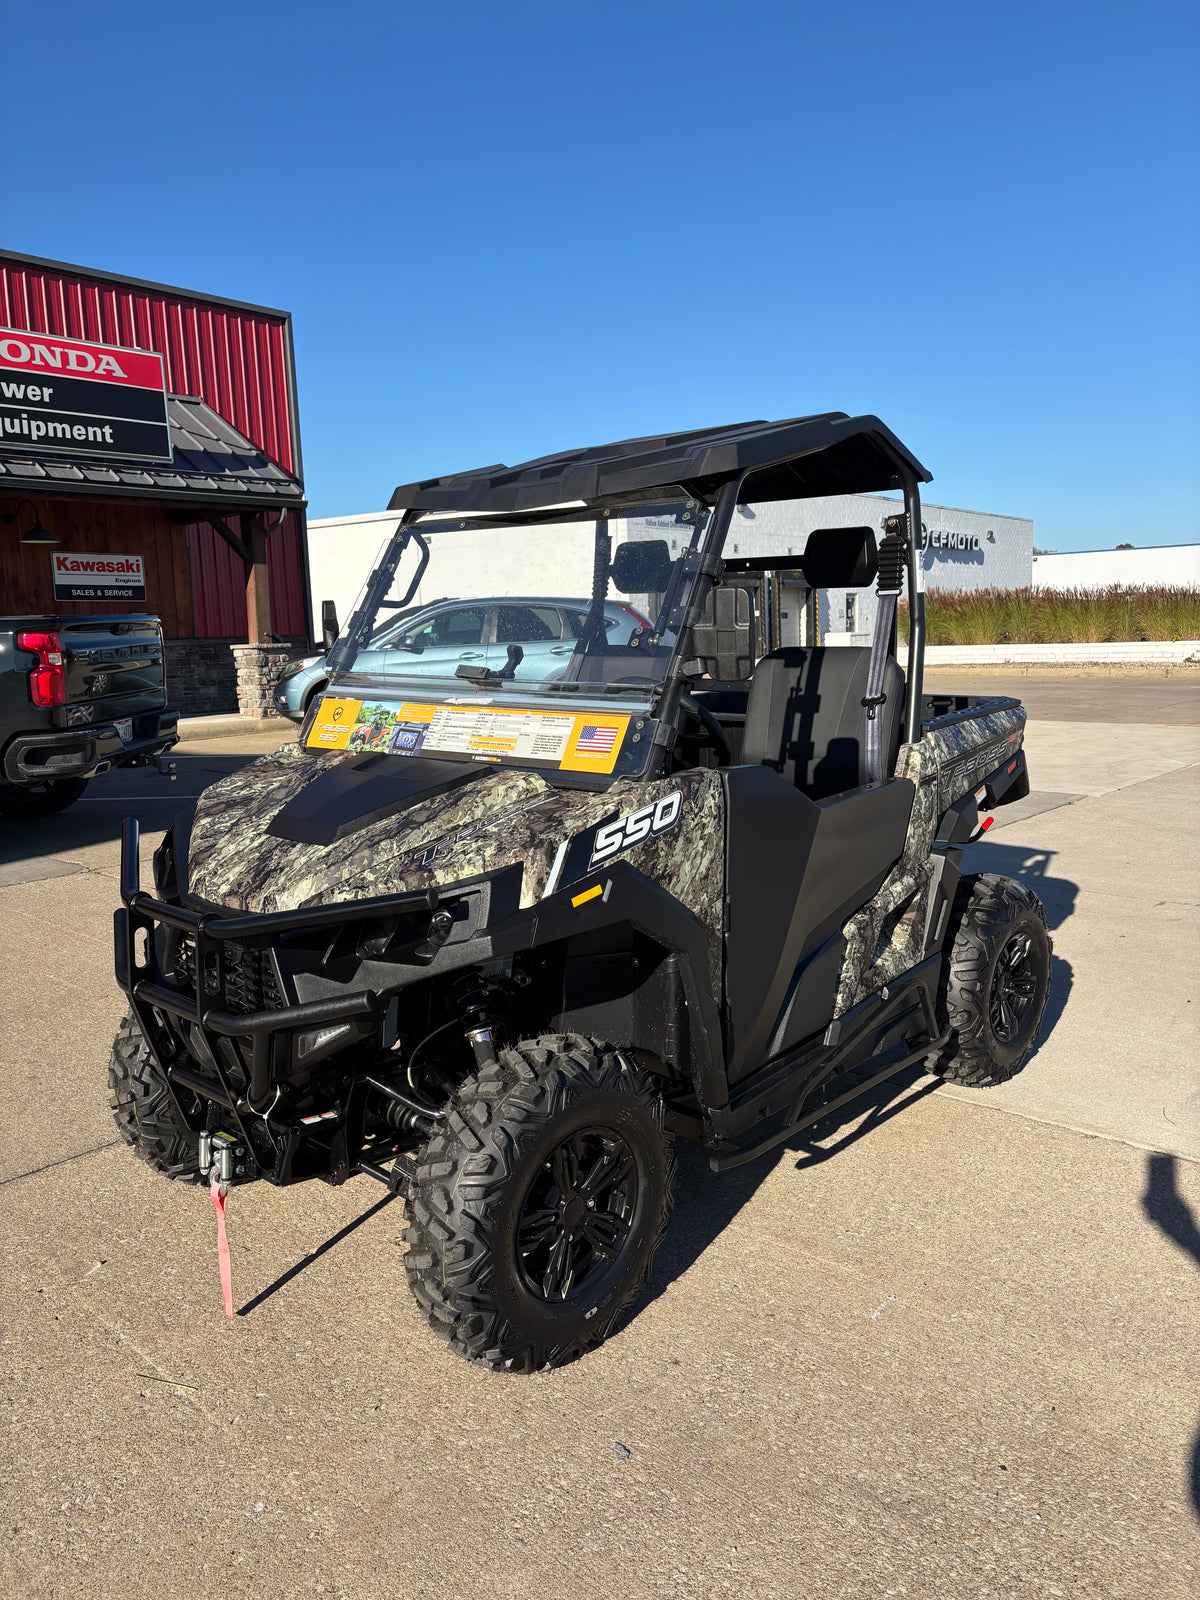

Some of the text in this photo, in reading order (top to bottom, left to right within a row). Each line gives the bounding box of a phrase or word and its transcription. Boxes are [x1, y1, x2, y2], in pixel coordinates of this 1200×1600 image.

[931, 530, 981, 551] CFMOTO
[55, 556, 141, 574] Kawasaki
[71, 588, 95, 596] SALES
[104, 589, 133, 597] SERVICE
[316, 723, 350, 733] T-BOSS
[318, 733, 339, 742] 550
[588, 790, 683, 869] 550
